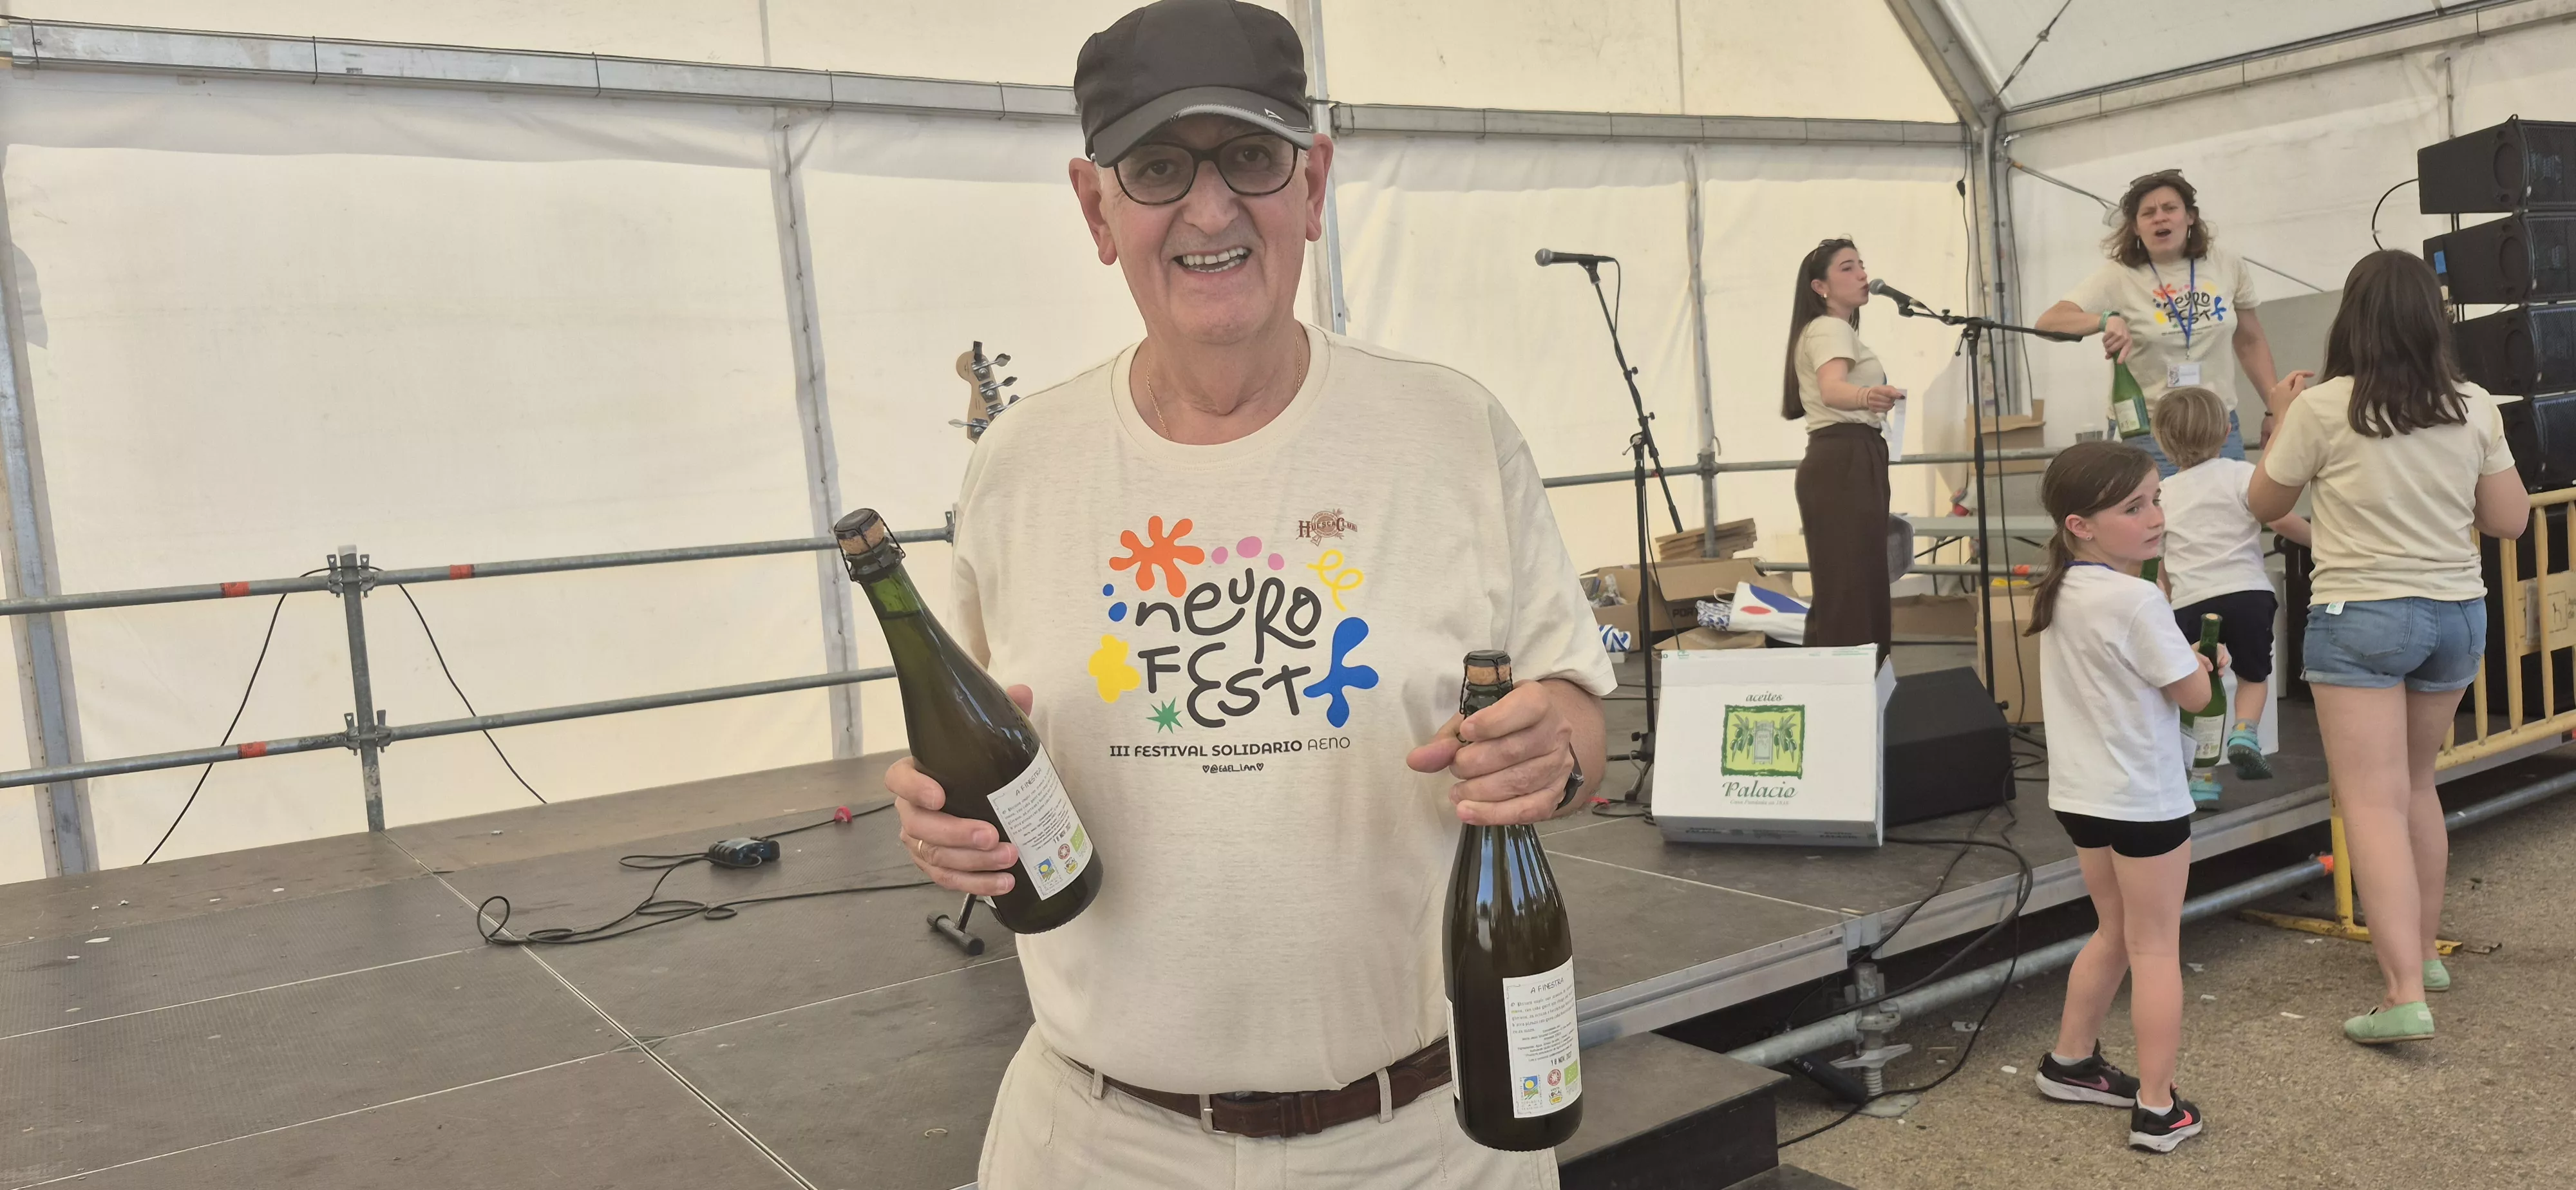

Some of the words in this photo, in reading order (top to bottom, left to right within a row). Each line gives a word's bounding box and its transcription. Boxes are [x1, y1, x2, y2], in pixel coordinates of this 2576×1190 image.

[1137, 642, 1311, 728] FEST
[1745, 691, 1783, 703] aceites
[1110, 745, 1130, 757] III
[1134, 745, 1208, 757] FESTIVAL
[1211, 740, 1303, 757] SOLIDARIO
[1307, 737, 1350, 751] AENO
[1721, 780, 1799, 798] Palacio
[1537, 978, 1564, 992] FINESTRA
